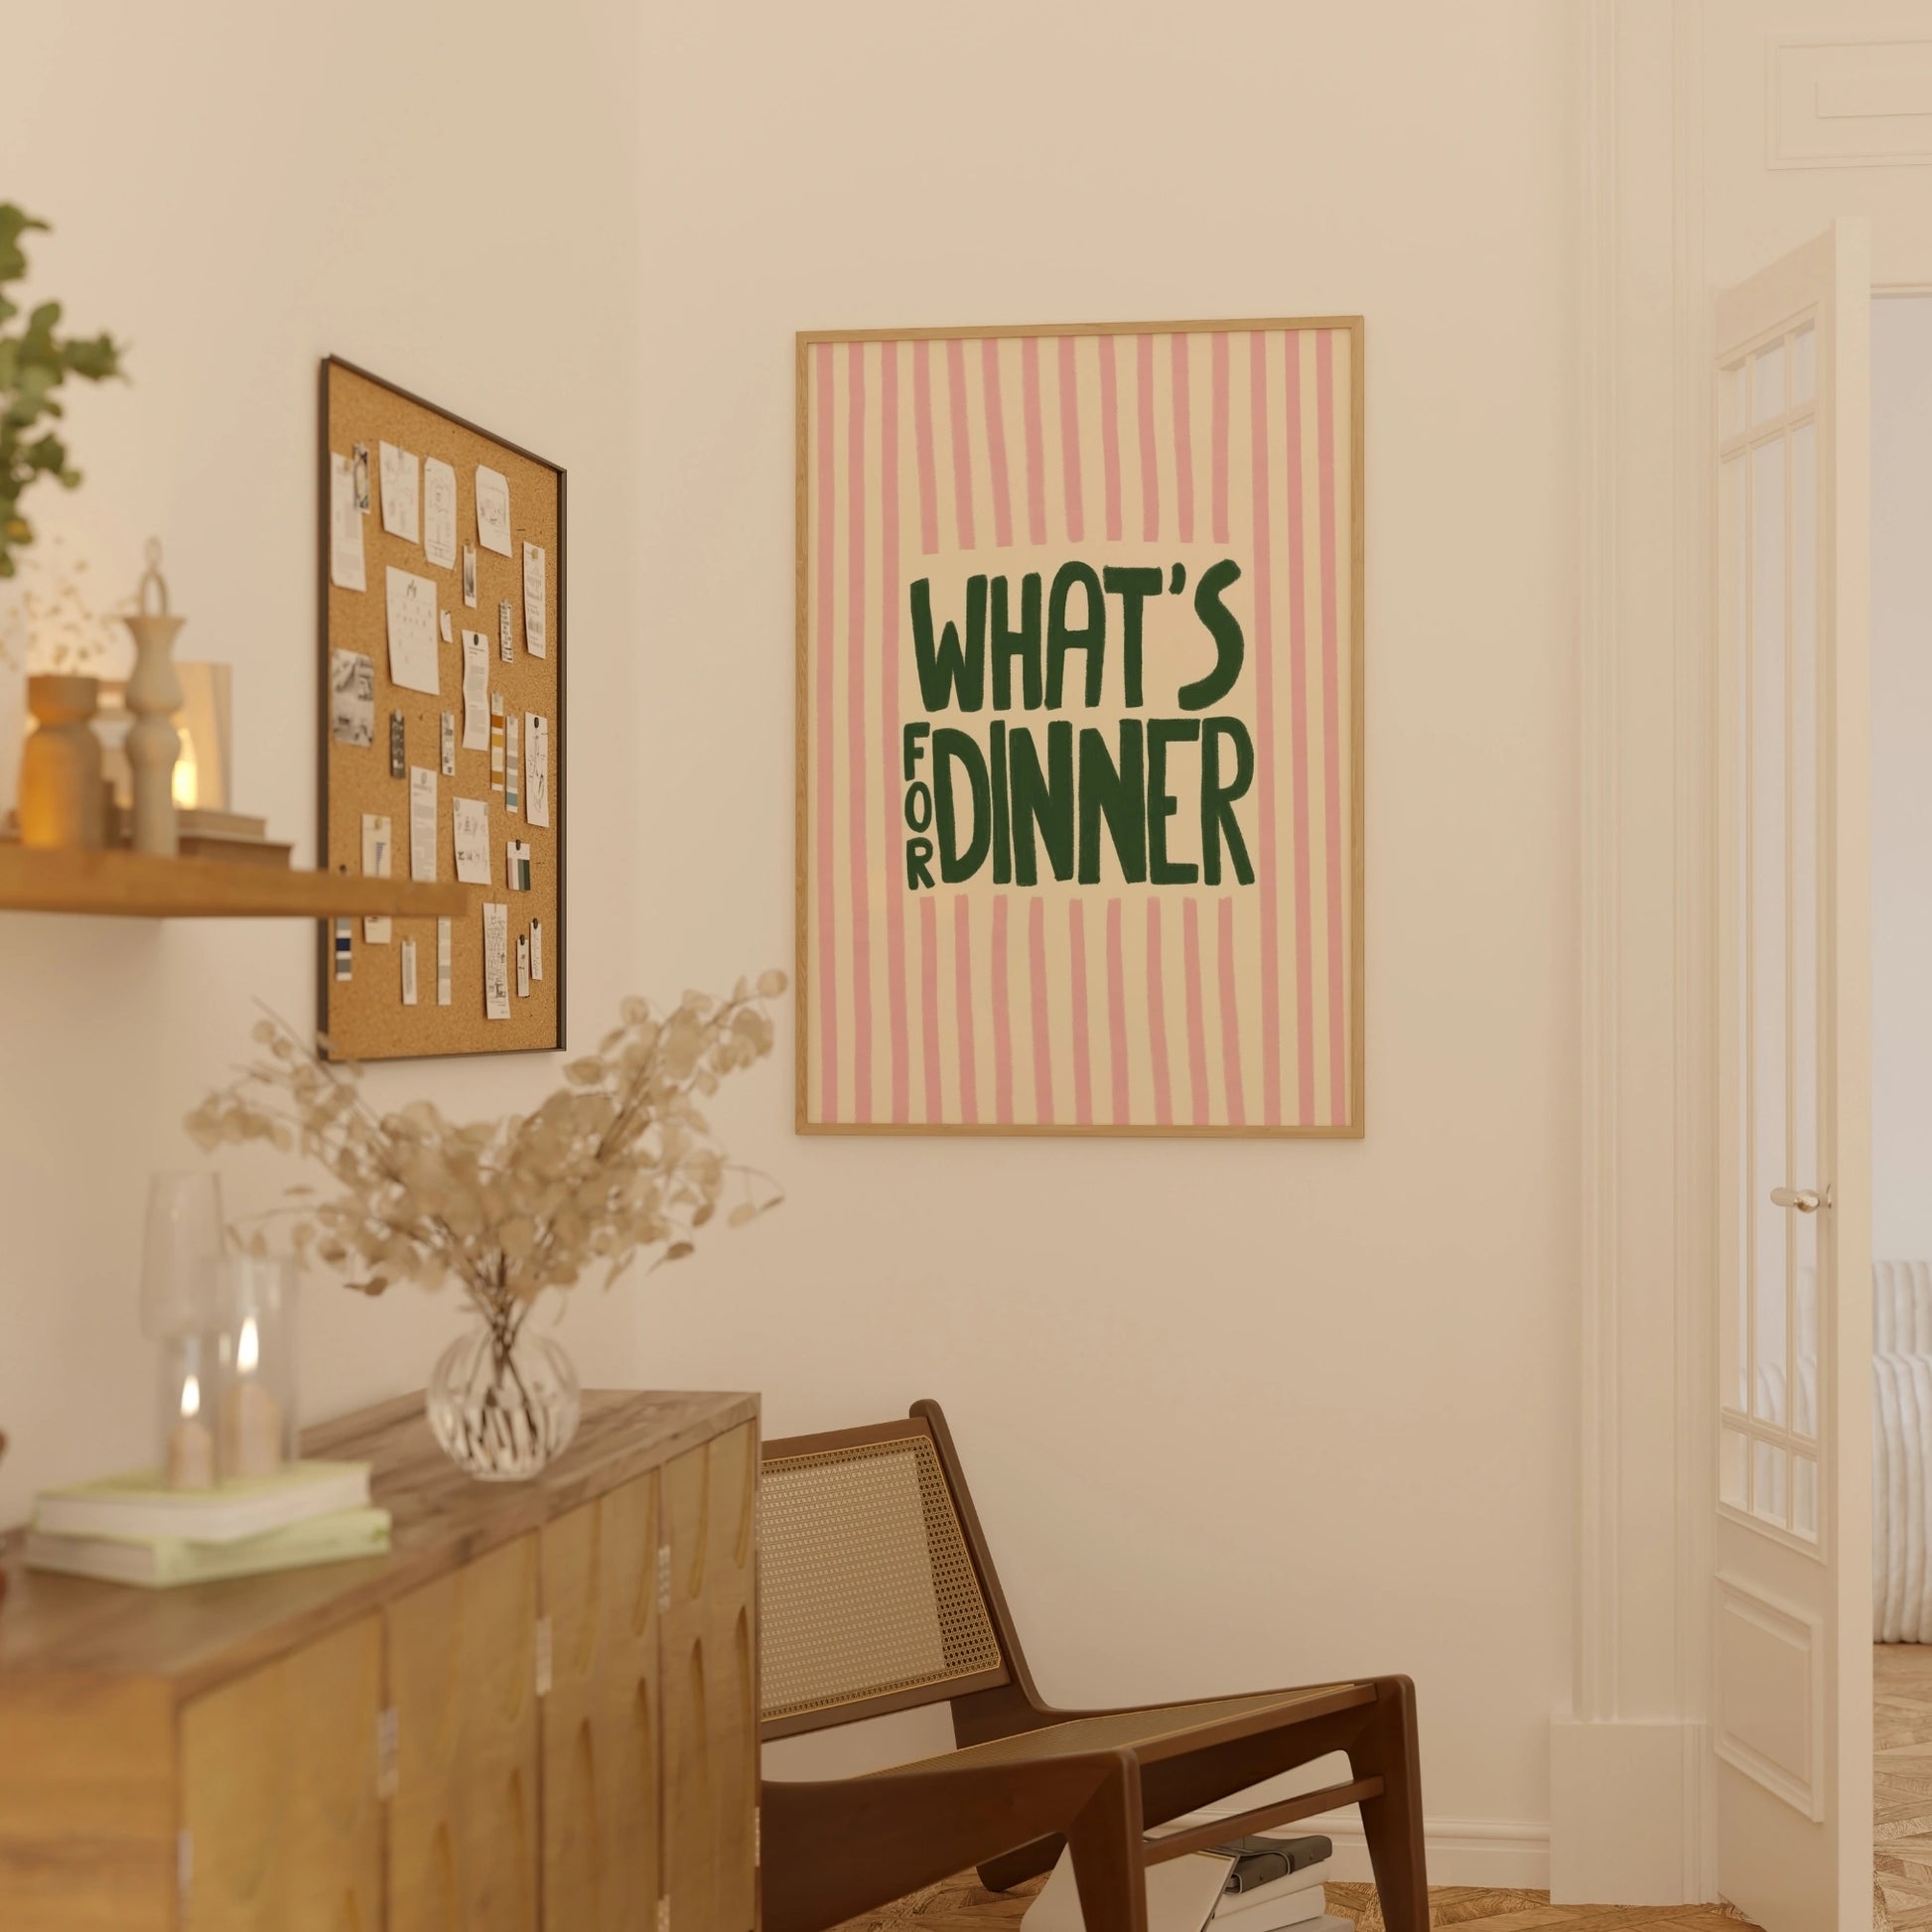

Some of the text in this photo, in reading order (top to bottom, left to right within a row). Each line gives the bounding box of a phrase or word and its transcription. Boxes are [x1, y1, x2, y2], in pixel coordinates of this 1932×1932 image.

[910, 559, 1245, 712] WHAT'S
[903, 717, 1255, 891] FOR DINNER
